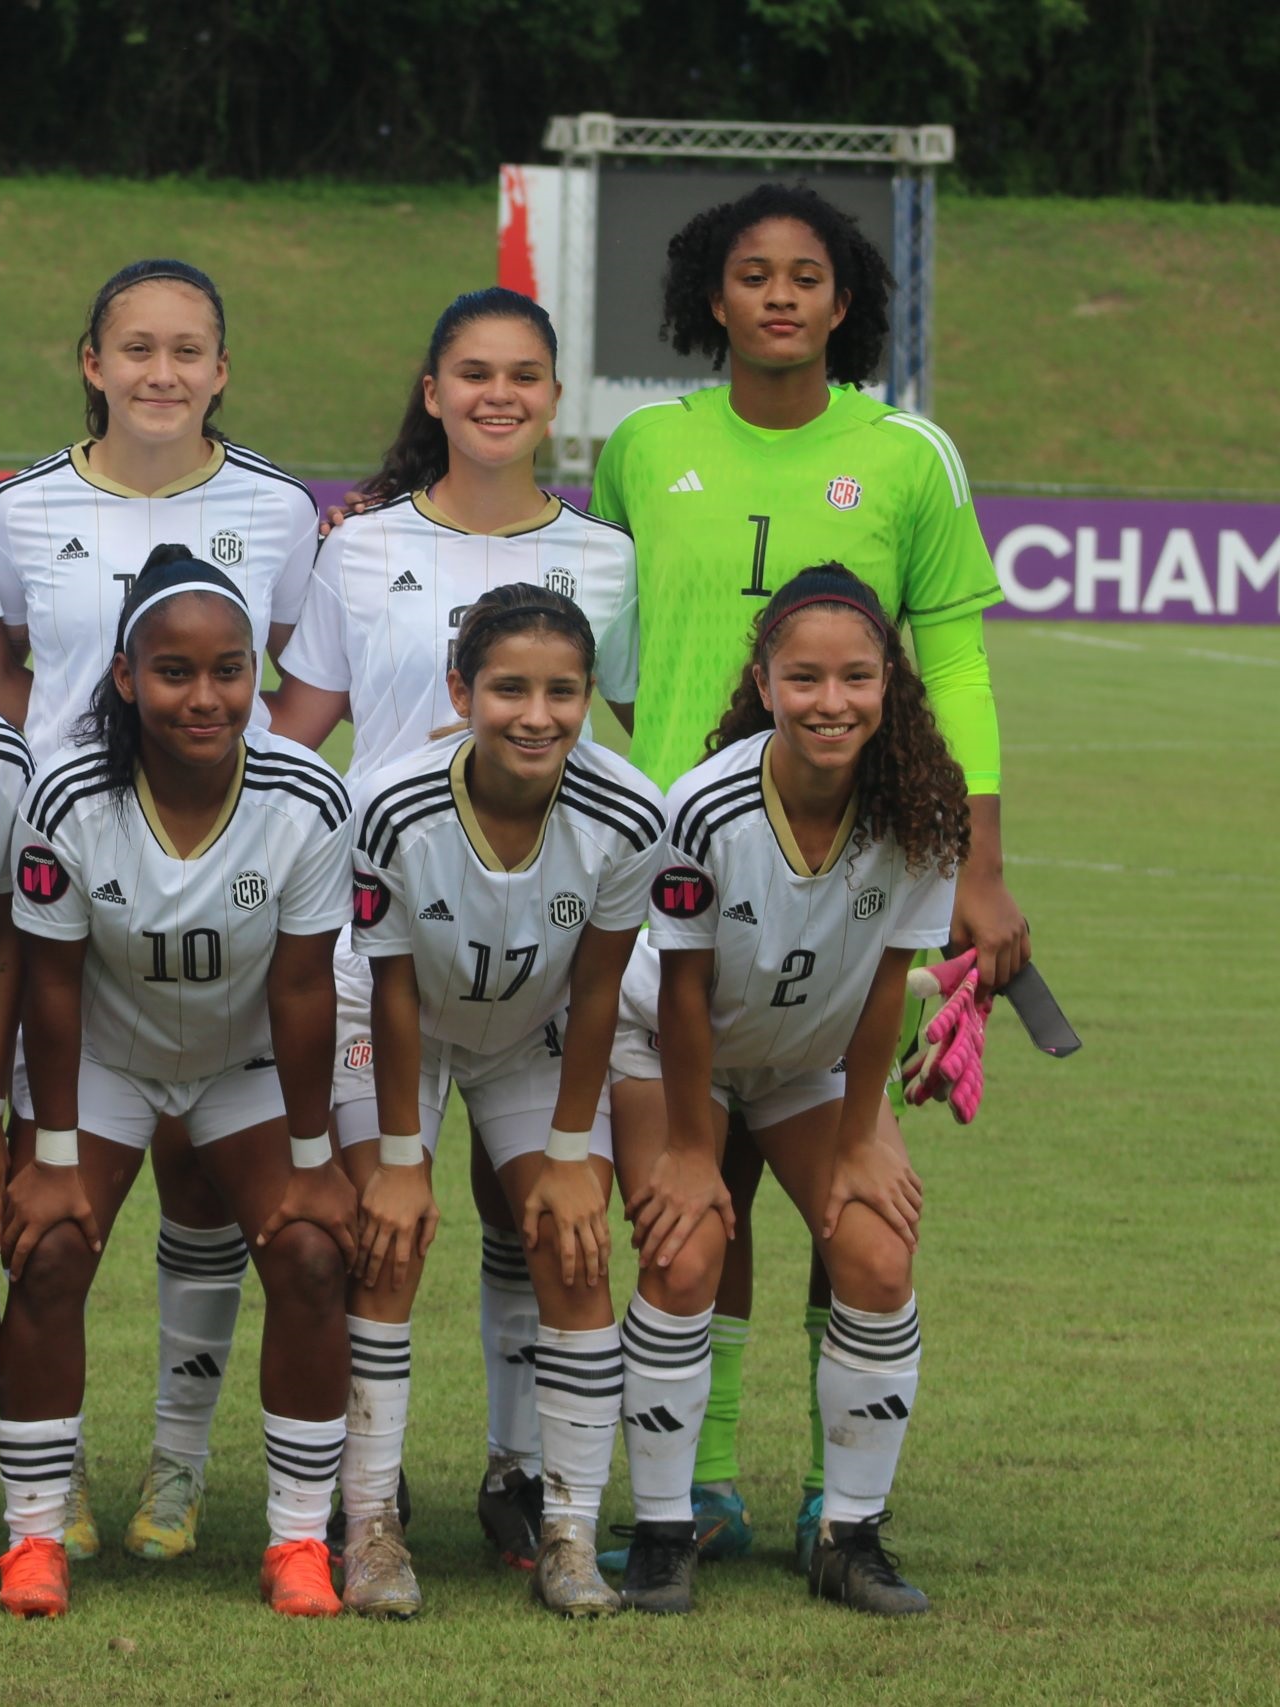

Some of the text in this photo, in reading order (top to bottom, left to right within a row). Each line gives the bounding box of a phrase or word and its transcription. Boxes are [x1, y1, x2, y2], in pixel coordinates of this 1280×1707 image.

[56, 550, 90, 561] adidas
[741, 514, 773, 597] 1
[994, 524, 1280, 615] CHAM
[389, 583, 423, 593] adidas
[90, 890, 127, 905] adidas
[419, 911, 455, 921] adidas
[722, 909, 758, 925] adidas
[142, 927, 222, 983] 10
[459, 940, 540, 1002] 17
[770, 949, 816, 1008] 2
